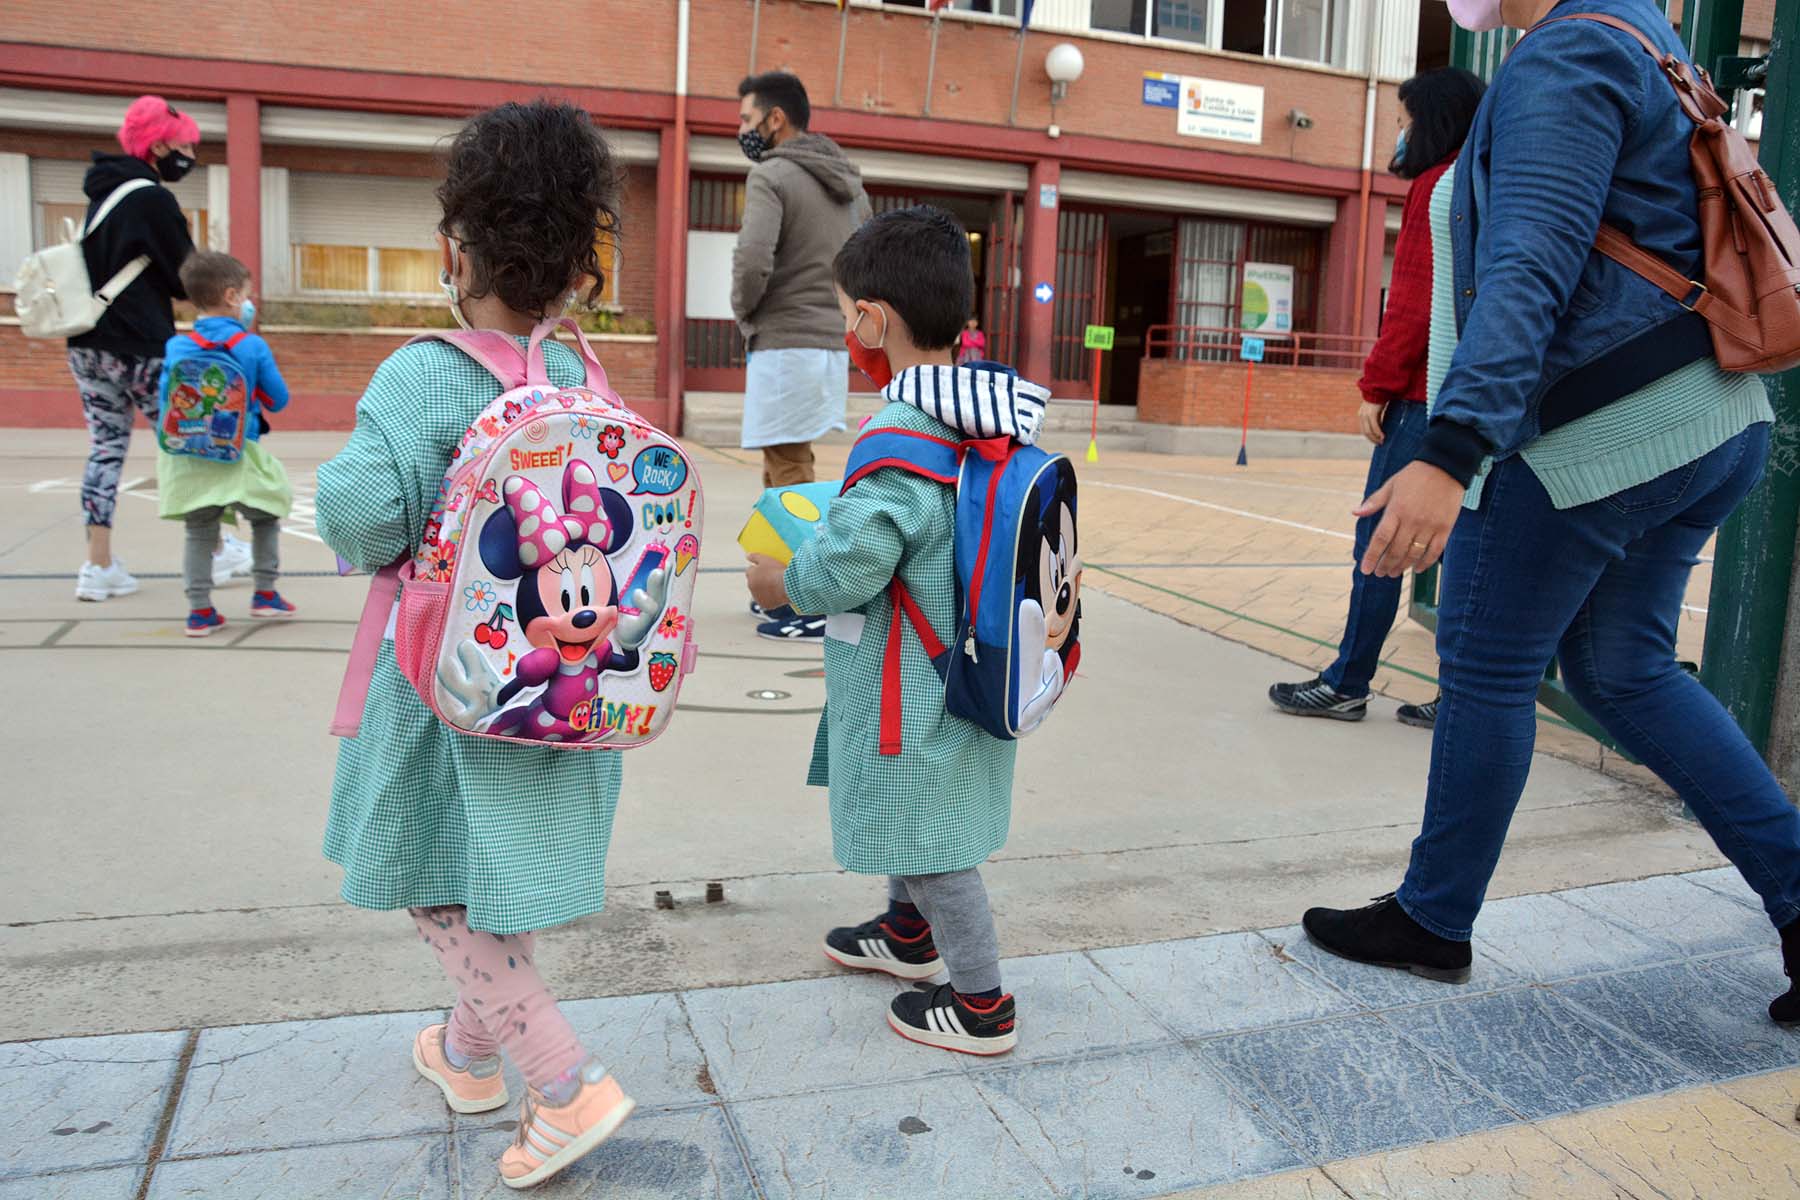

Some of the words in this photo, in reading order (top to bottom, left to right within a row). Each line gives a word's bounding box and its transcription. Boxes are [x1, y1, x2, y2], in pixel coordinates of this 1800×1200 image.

[654, 450, 671, 468] WE
[642, 465, 678, 490] ROCK!
[642, 489, 697, 530] COOL!
[570, 697, 604, 731] OH
[606, 702, 656, 735] MY!
